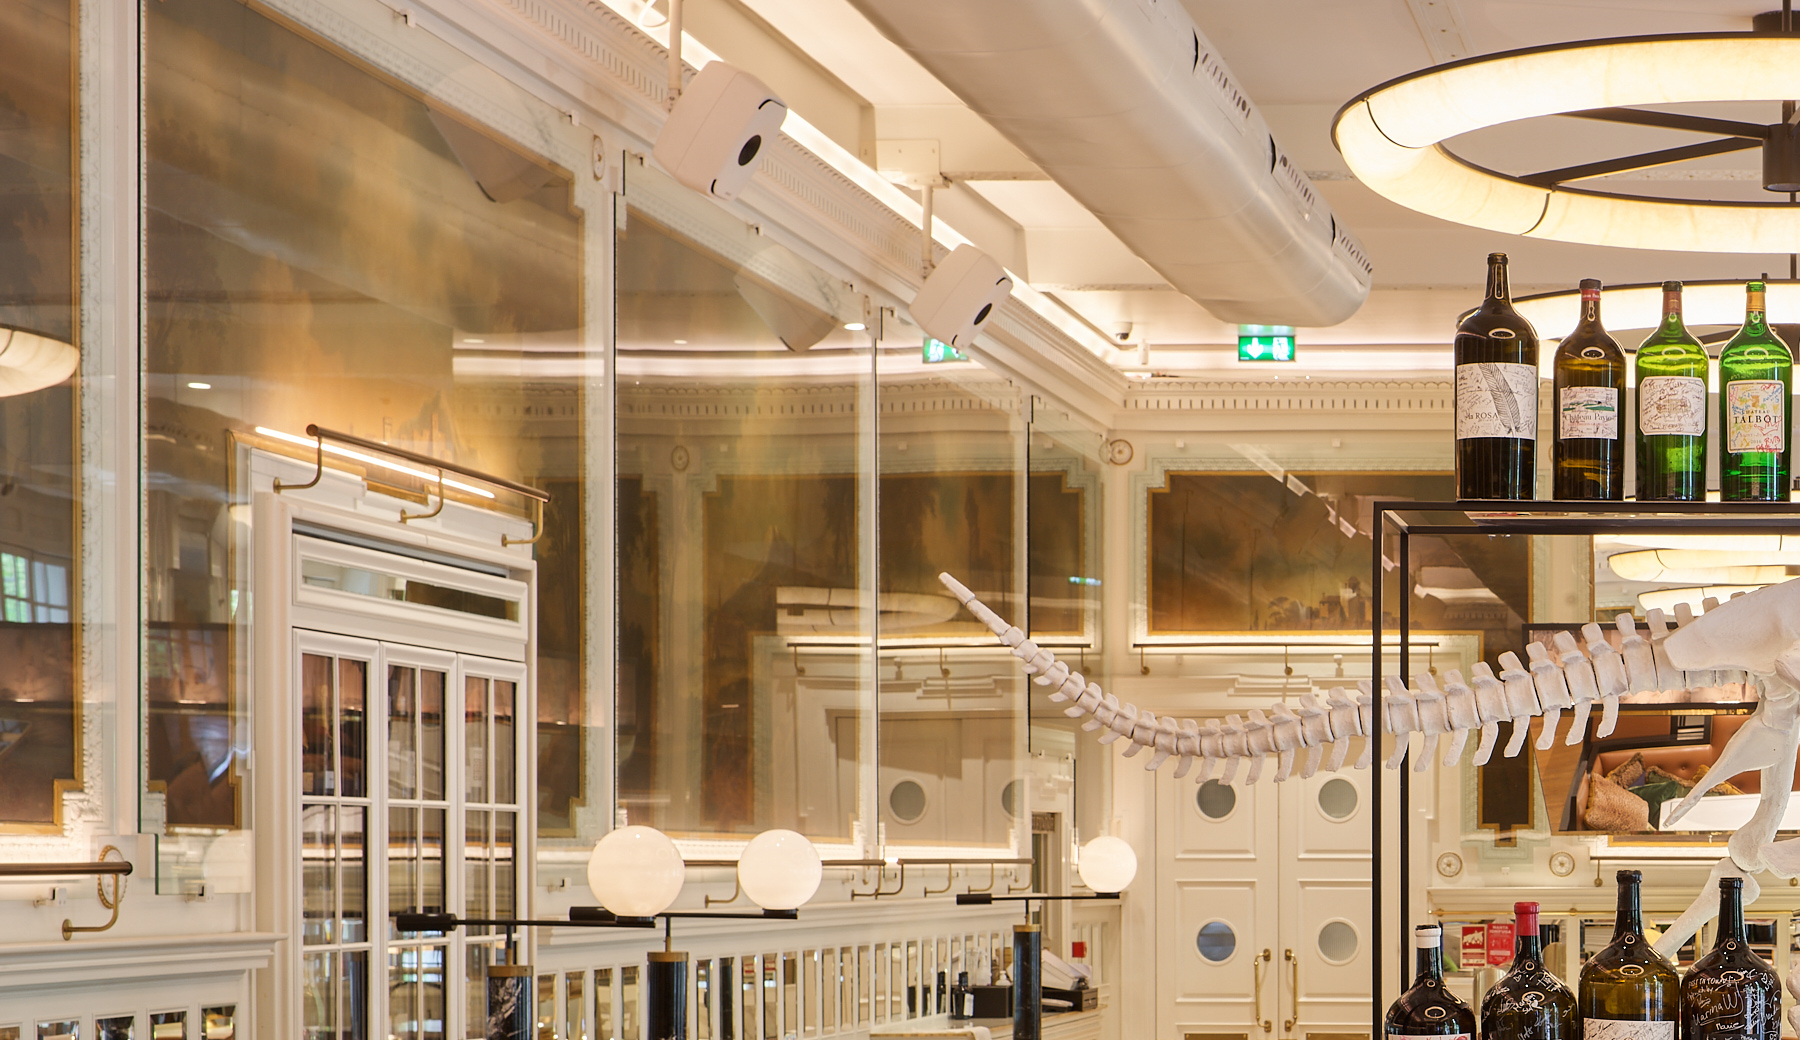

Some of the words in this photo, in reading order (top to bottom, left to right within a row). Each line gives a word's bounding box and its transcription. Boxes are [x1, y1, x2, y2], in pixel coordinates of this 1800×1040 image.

[1475, 411, 1499, 420] ROSA
[1564, 412, 1592, 421] Château
[1733, 414, 1781, 424] TALBOT
